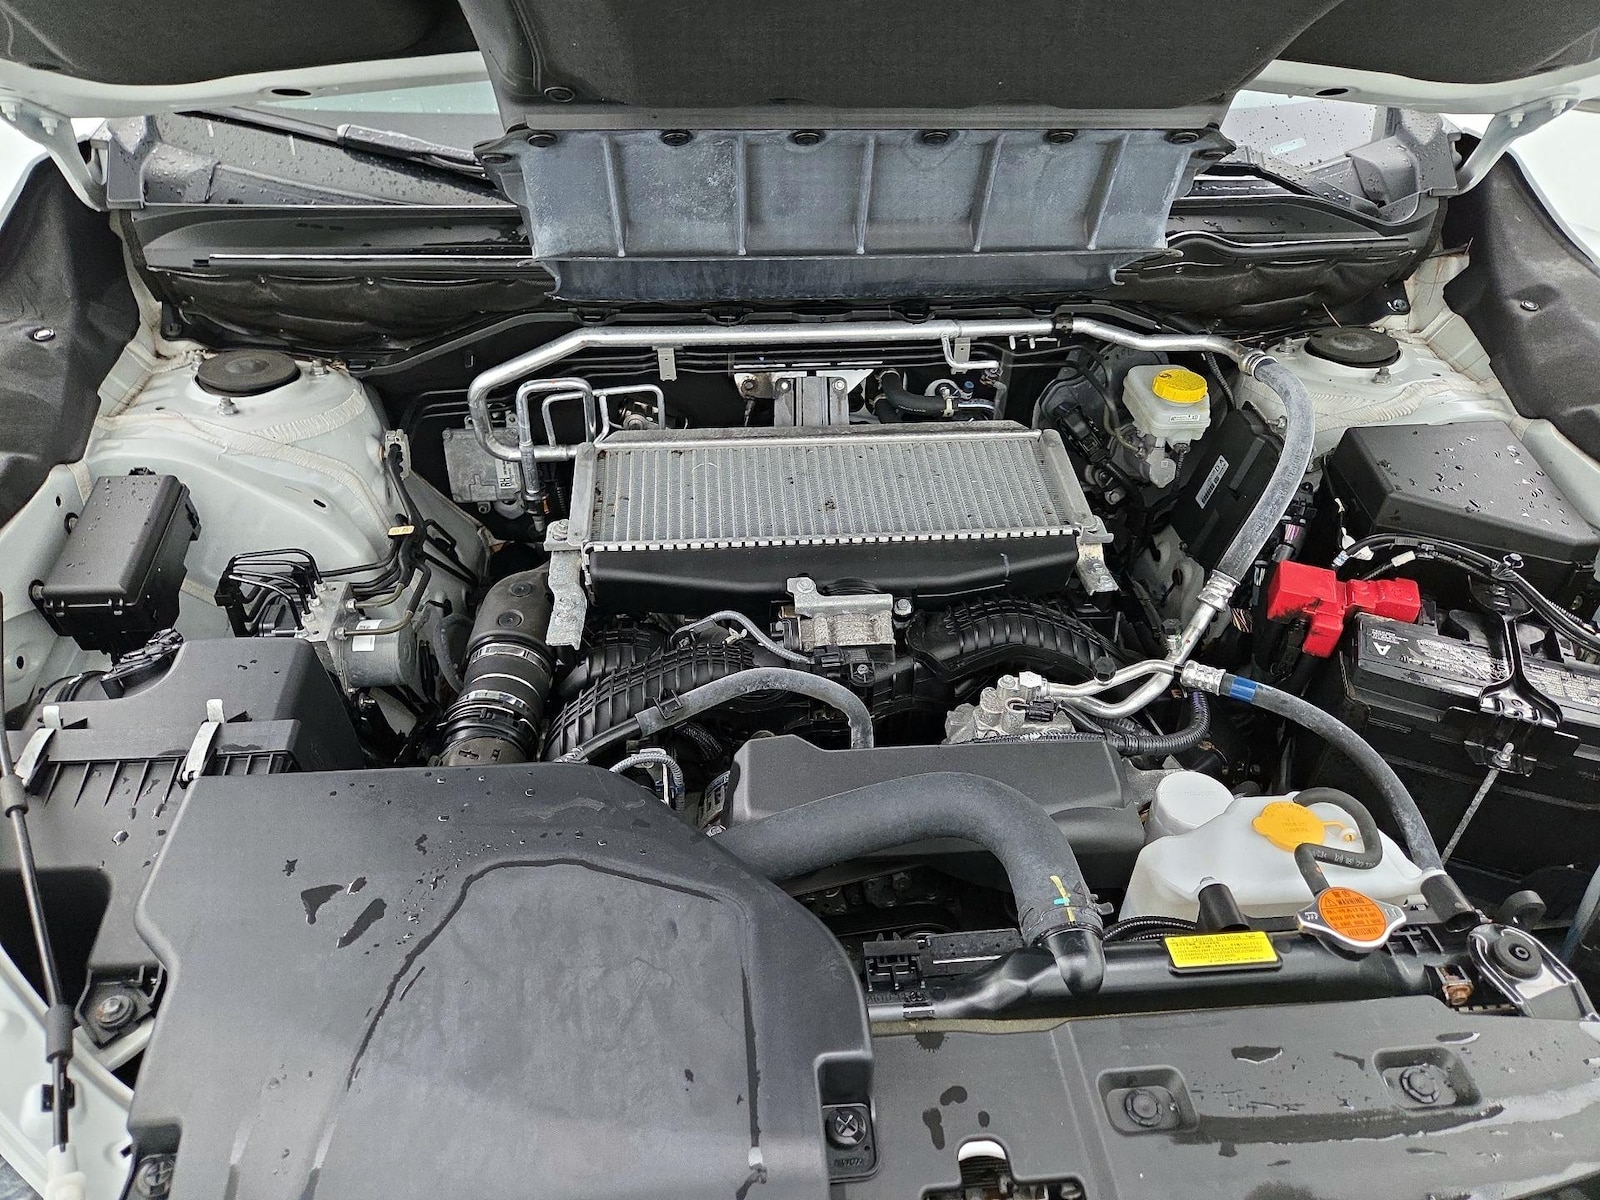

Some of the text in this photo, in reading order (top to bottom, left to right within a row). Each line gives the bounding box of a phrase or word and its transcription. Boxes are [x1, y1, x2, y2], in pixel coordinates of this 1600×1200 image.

[500, 477, 512, 487] RH
[1373, 642, 1391, 656] A
[1338, 897, 1365, 905] WARNING
